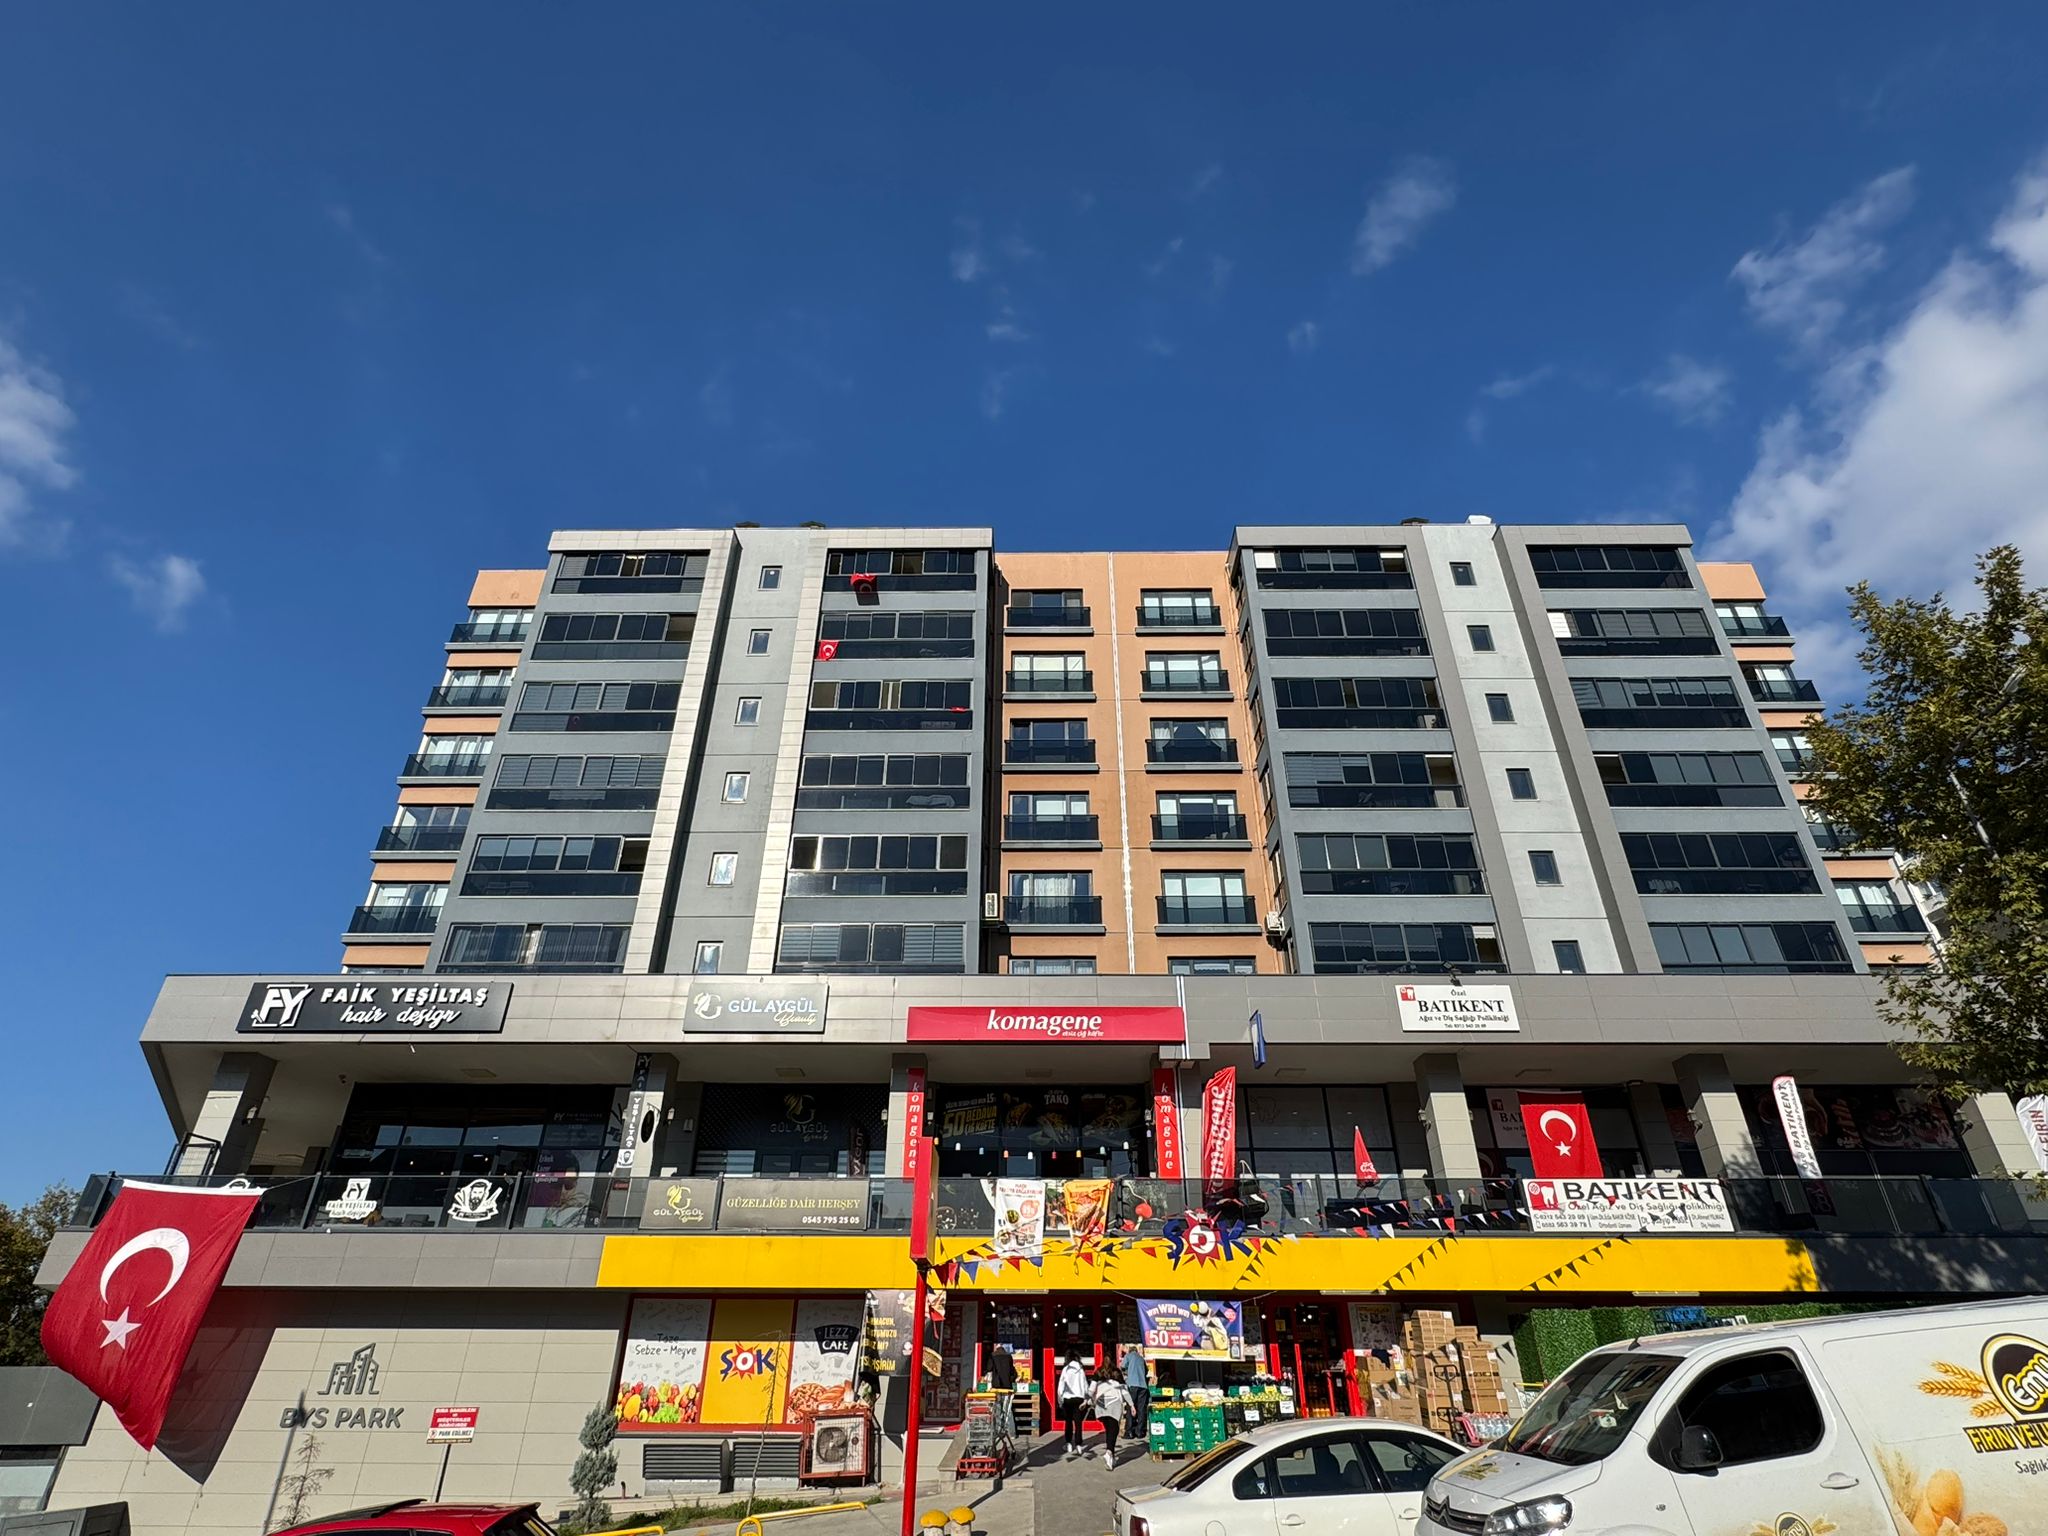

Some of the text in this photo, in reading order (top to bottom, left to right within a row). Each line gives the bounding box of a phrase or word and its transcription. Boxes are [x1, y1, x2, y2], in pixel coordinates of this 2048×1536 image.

[320, 983, 488, 1006] FAİK YEŞİLTAŞ
[728, 998, 818, 1013] GÜL AYGÜL
[1418, 1000, 1504, 1012] BATIKENT
[340, 1005, 462, 1029] hair design
[987, 1009, 1102, 1036] komagene
[1044, 1094, 1069, 1105] TAKO
[1778, 1083, 1801, 1149] BATIKENT
[908, 1082, 920, 1169] komagene
[1160, 1082, 1174, 1170] komagene
[1563, 1182, 1719, 1200] BATIKENT
[653, 1208, 672, 1216] GÜL
[726, 1198, 860, 1210] GÜZELLİĞE DAİR HERŞEY
[1629, 1203, 1644, 1212] Diş
[802, 1216, 822, 1224] 0545
[823, 1216, 838, 1224] 795
[1163, 1218, 1252, 1271] ŞOK
[657, 1333, 680, 1343] Taze
[824, 1327, 849, 1339] LEZZ
[1149, 1330, 1168, 1346] 50
[635, 1344, 661, 1355] Sebze
[670, 1345, 697, 1360] Meyve
[822, 1340, 849, 1350] CAFE
[720, 1346, 776, 1382] ŞOK
[280, 1408, 405, 1429] BYS PARK
[1967, 1425, 2016, 1452] FIRIN
[2011, 1423, 2041, 1449] VE
